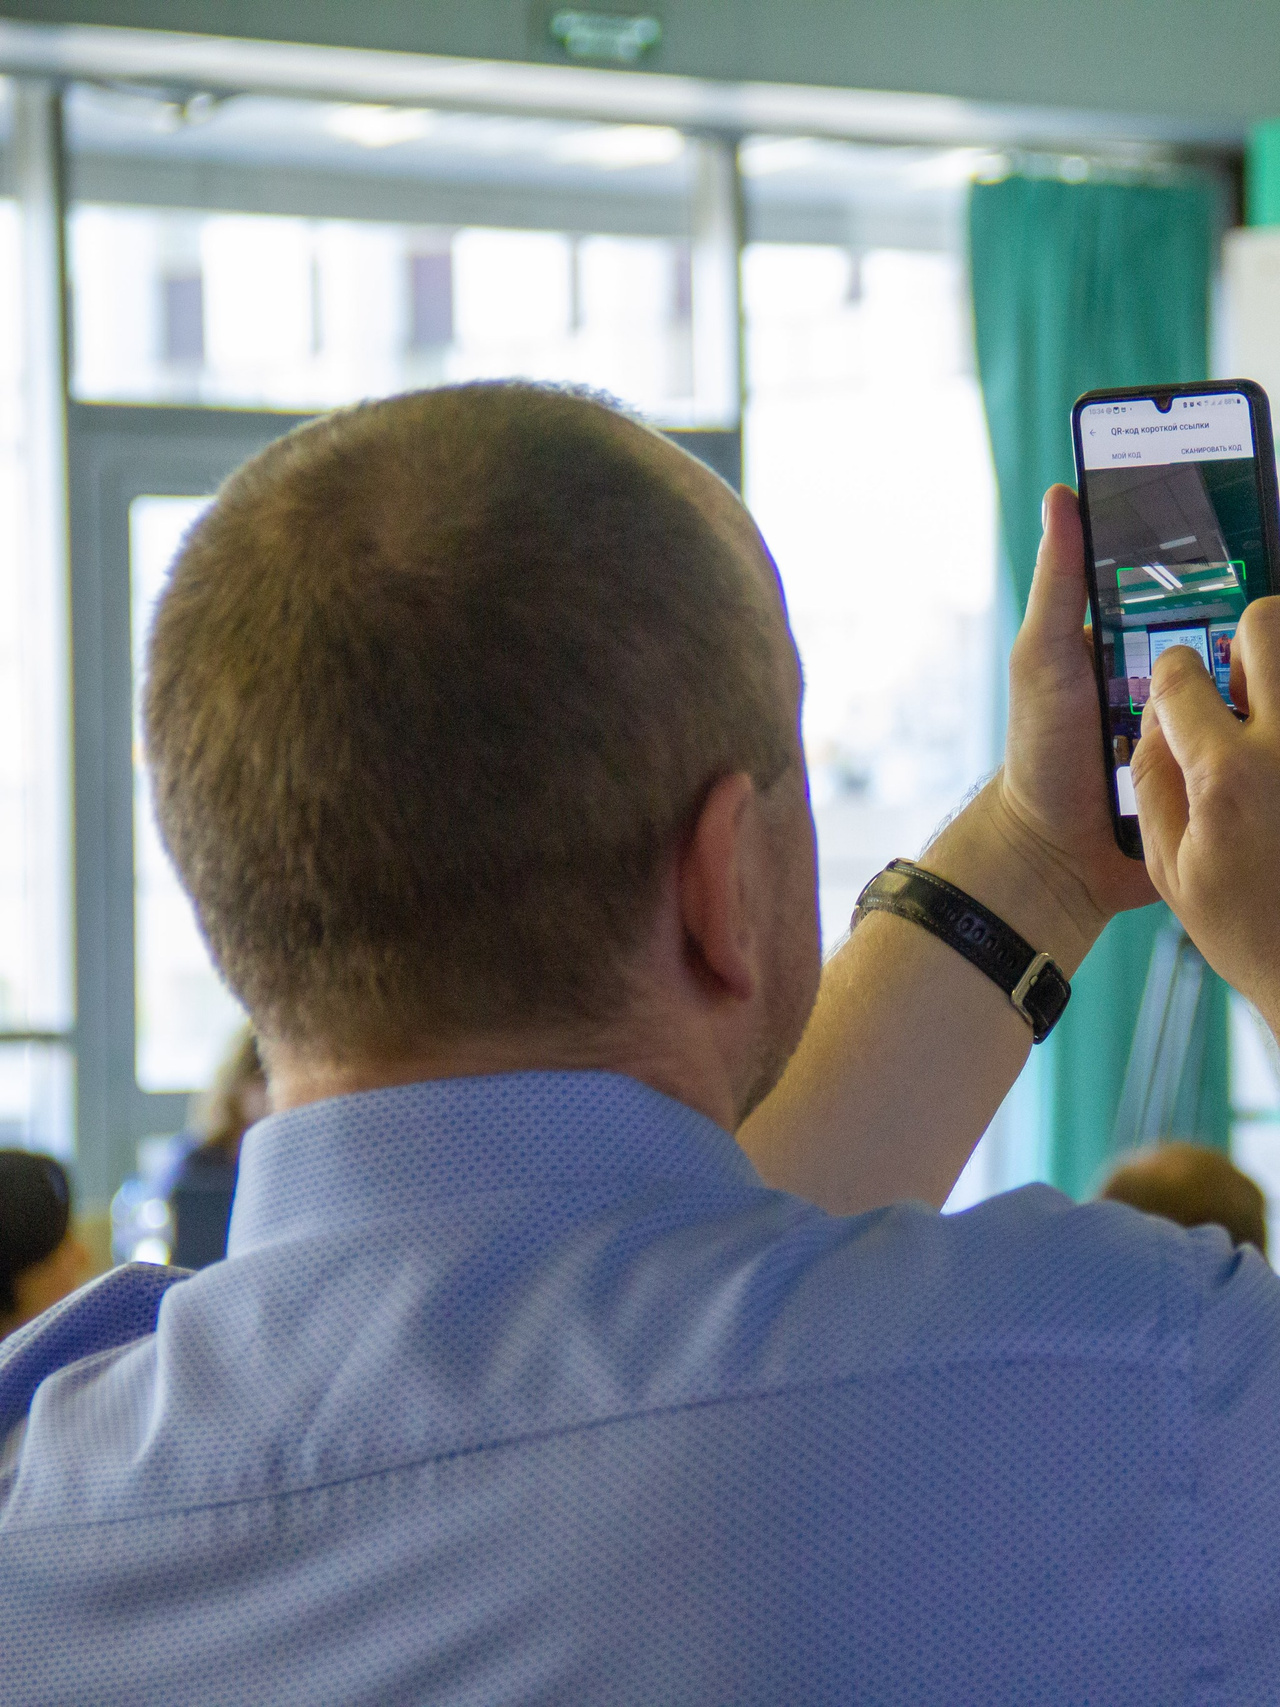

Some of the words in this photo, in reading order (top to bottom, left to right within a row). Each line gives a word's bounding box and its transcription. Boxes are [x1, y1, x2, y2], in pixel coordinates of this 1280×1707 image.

[1111, 427, 1139, 436] QR-код
[1141, 424, 1178, 434] короткой
[1179, 422, 1209, 431] ссылки
[1181, 446, 1227, 455] СКАНИРОВАТЬ
[1228, 444, 1242, 453] КОД
[1112, 452, 1127, 460] МОЙ
[1127, 451, 1141, 460] КОД
